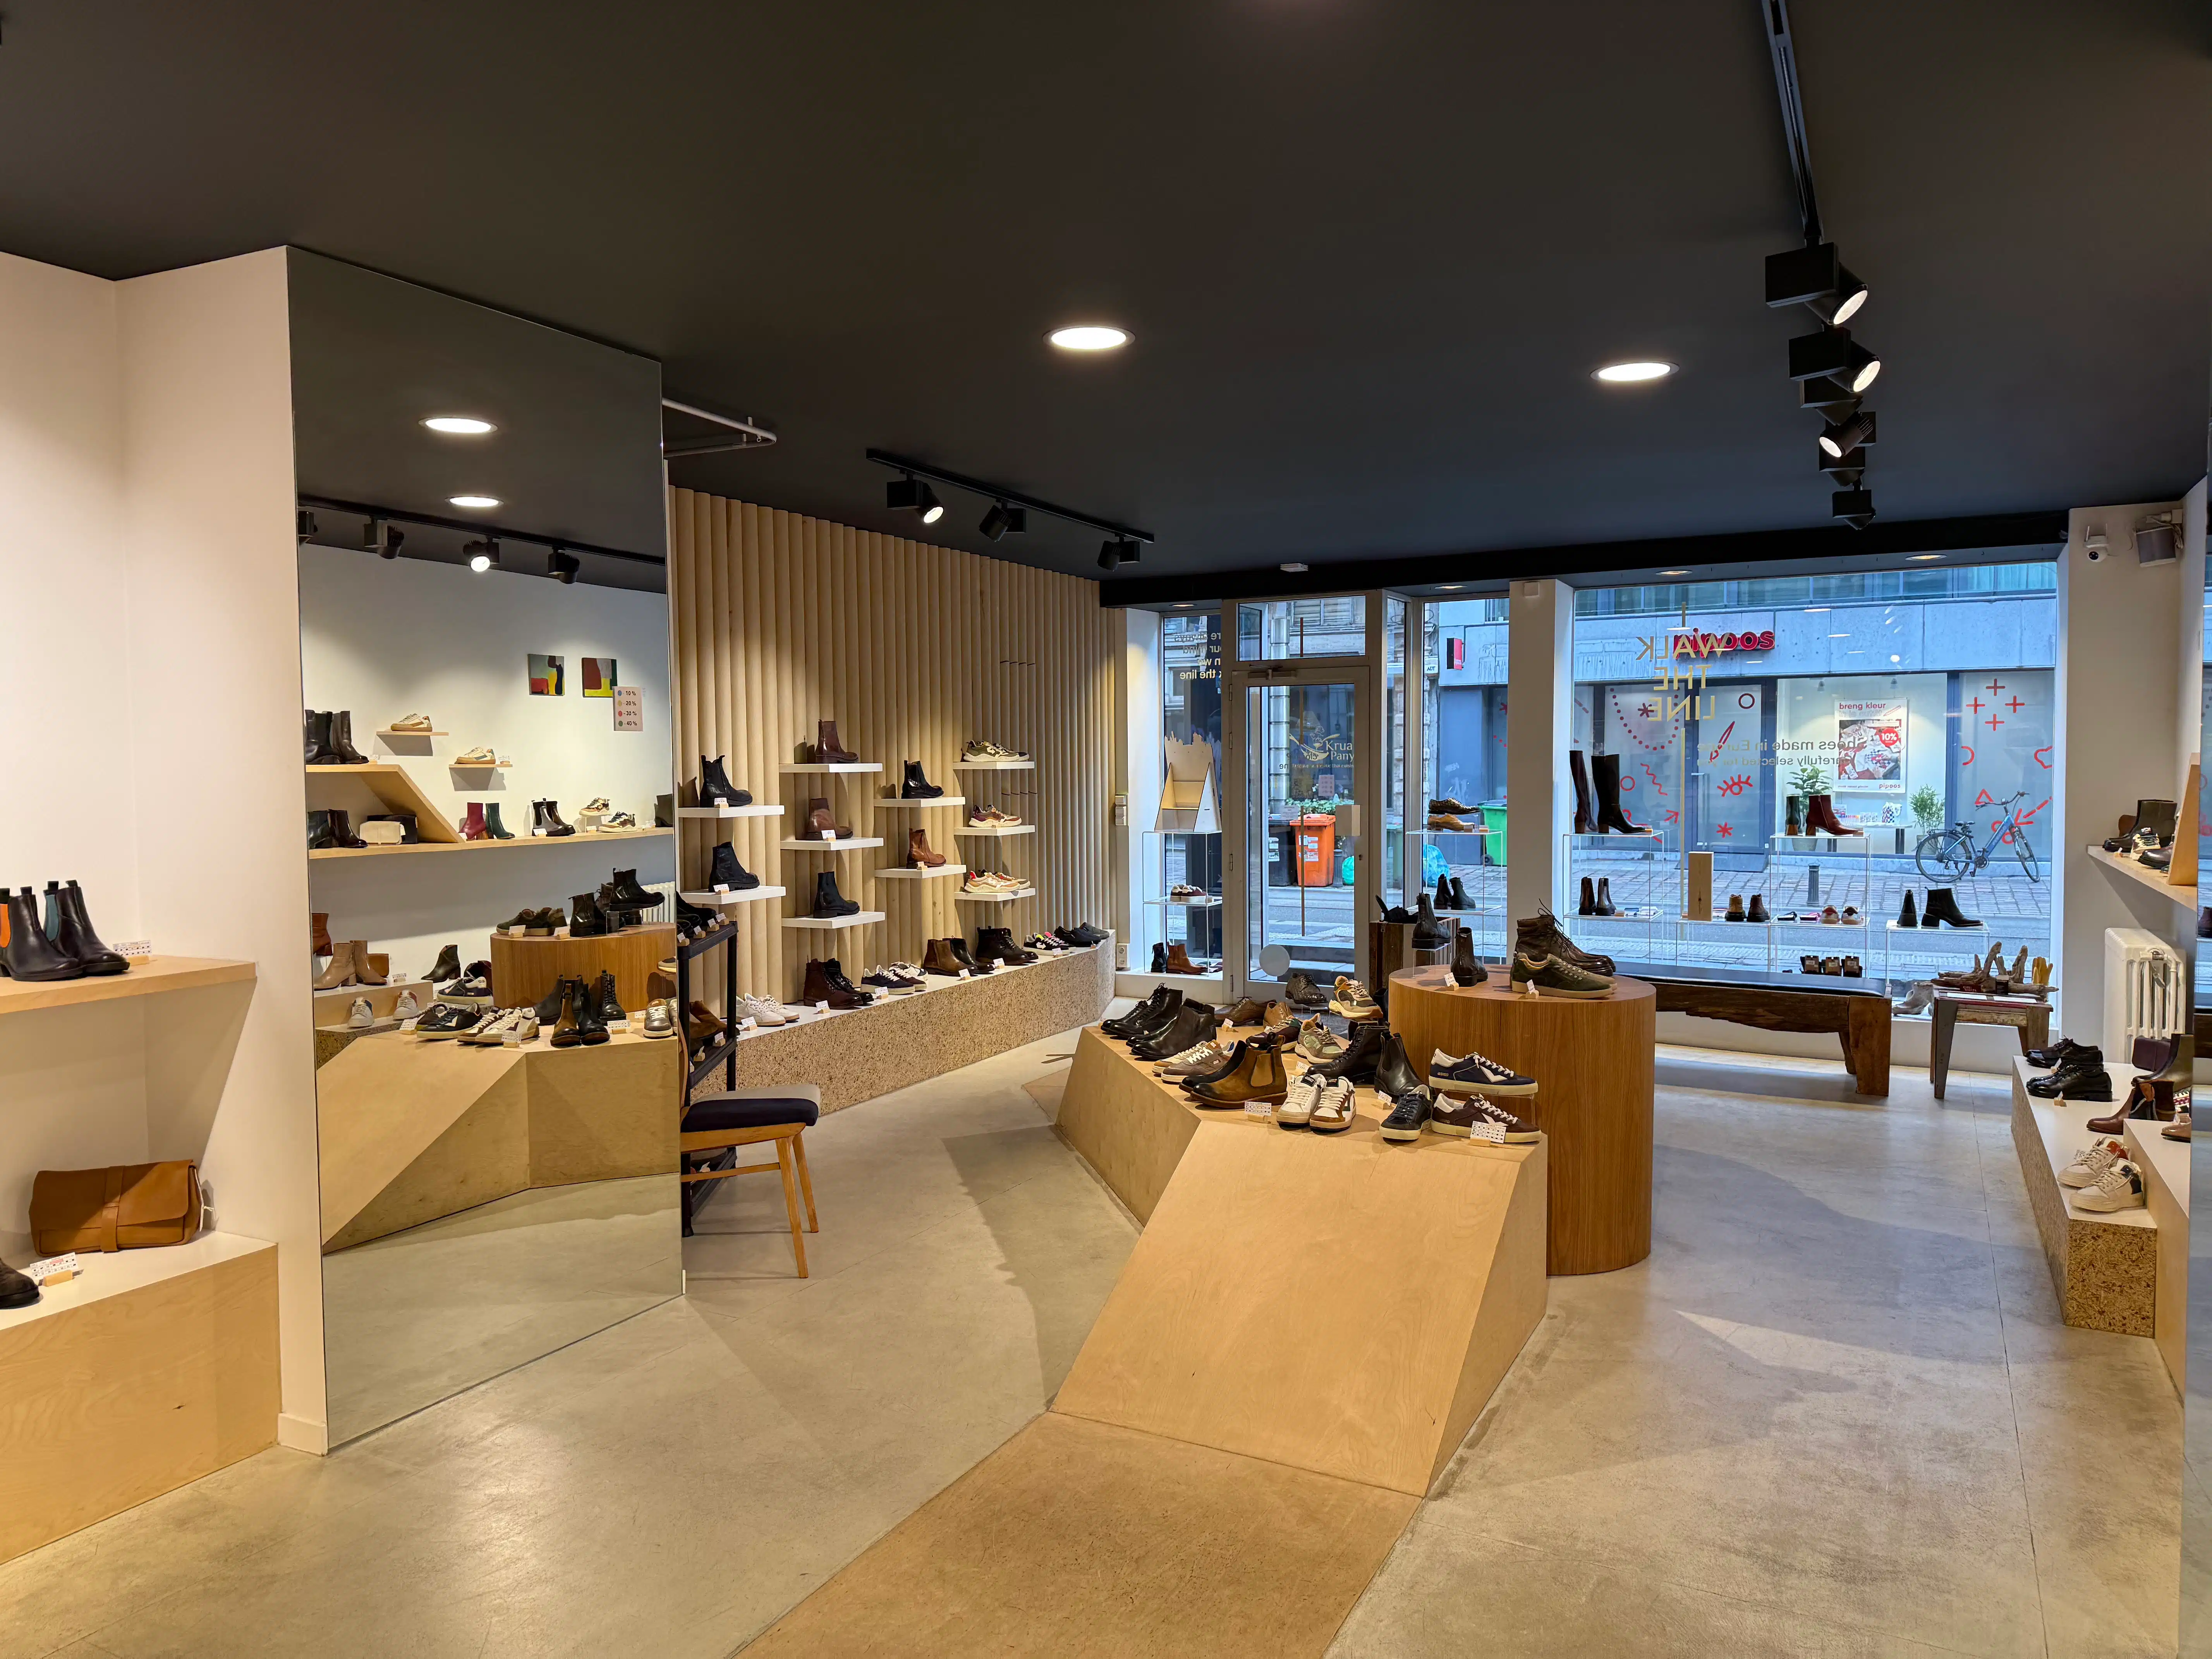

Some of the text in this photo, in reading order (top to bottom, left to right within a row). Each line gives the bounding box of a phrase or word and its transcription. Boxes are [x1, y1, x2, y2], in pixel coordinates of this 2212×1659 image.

[1839, 702, 1863, 711] breng
[1881, 733, 1897, 741] 10%
[1325, 740, 1352, 750] Krua
